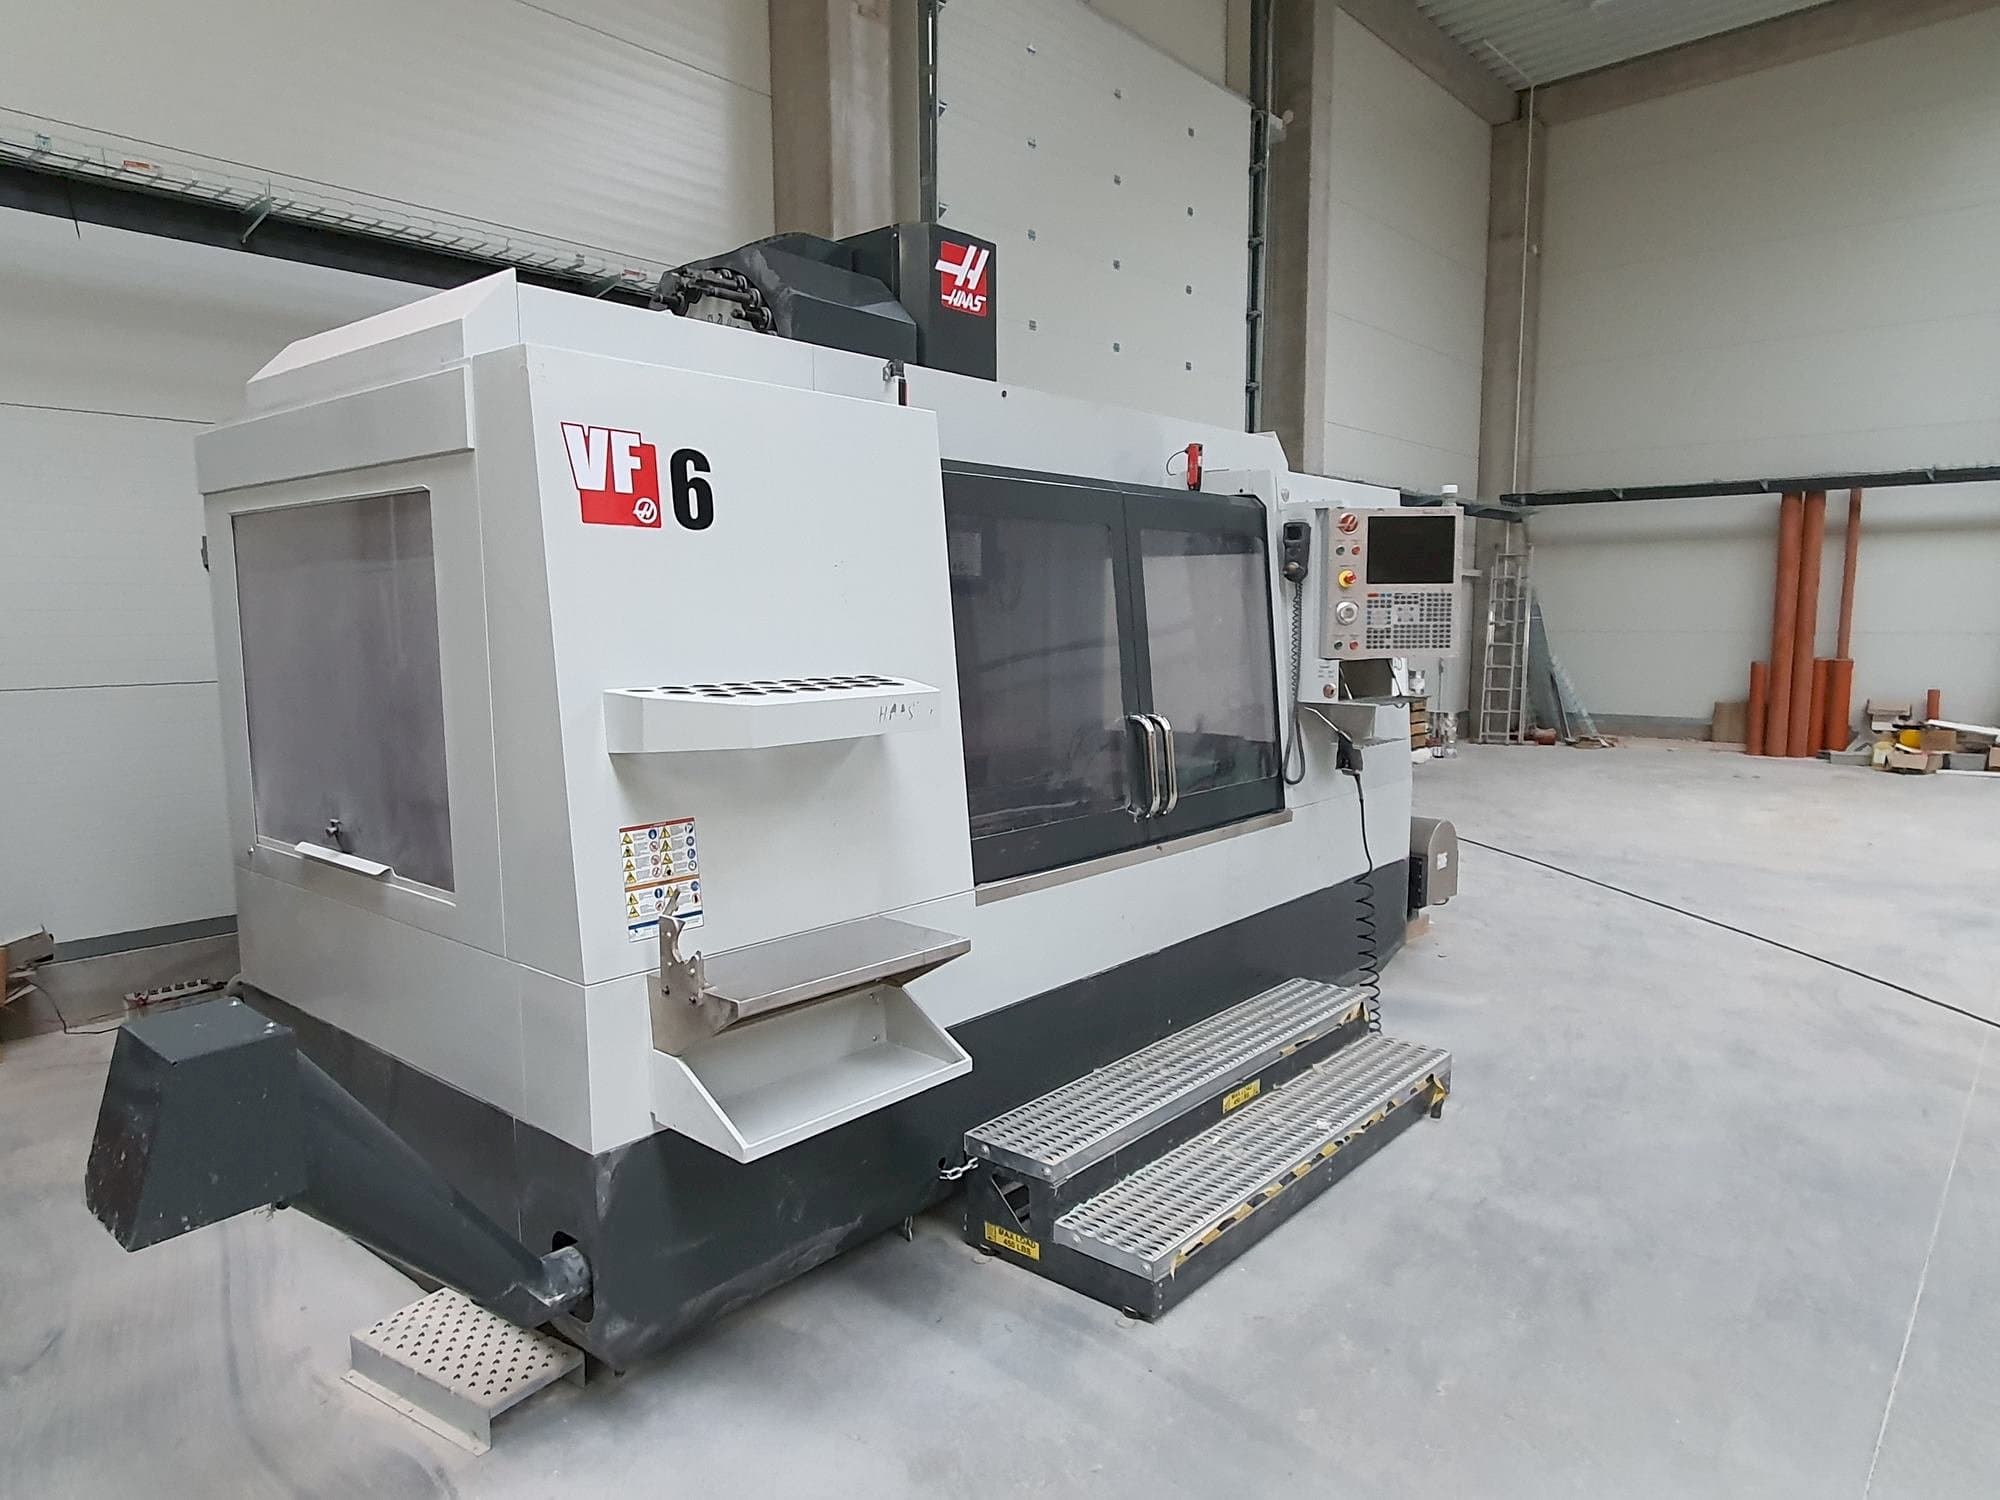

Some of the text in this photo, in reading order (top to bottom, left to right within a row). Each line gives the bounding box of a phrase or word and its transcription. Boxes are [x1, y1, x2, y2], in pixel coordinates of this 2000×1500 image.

[942, 289, 987, 312] HAAS
[561, 422, 714, 531] VF 6
[879, 703, 914, 723] HAAS
